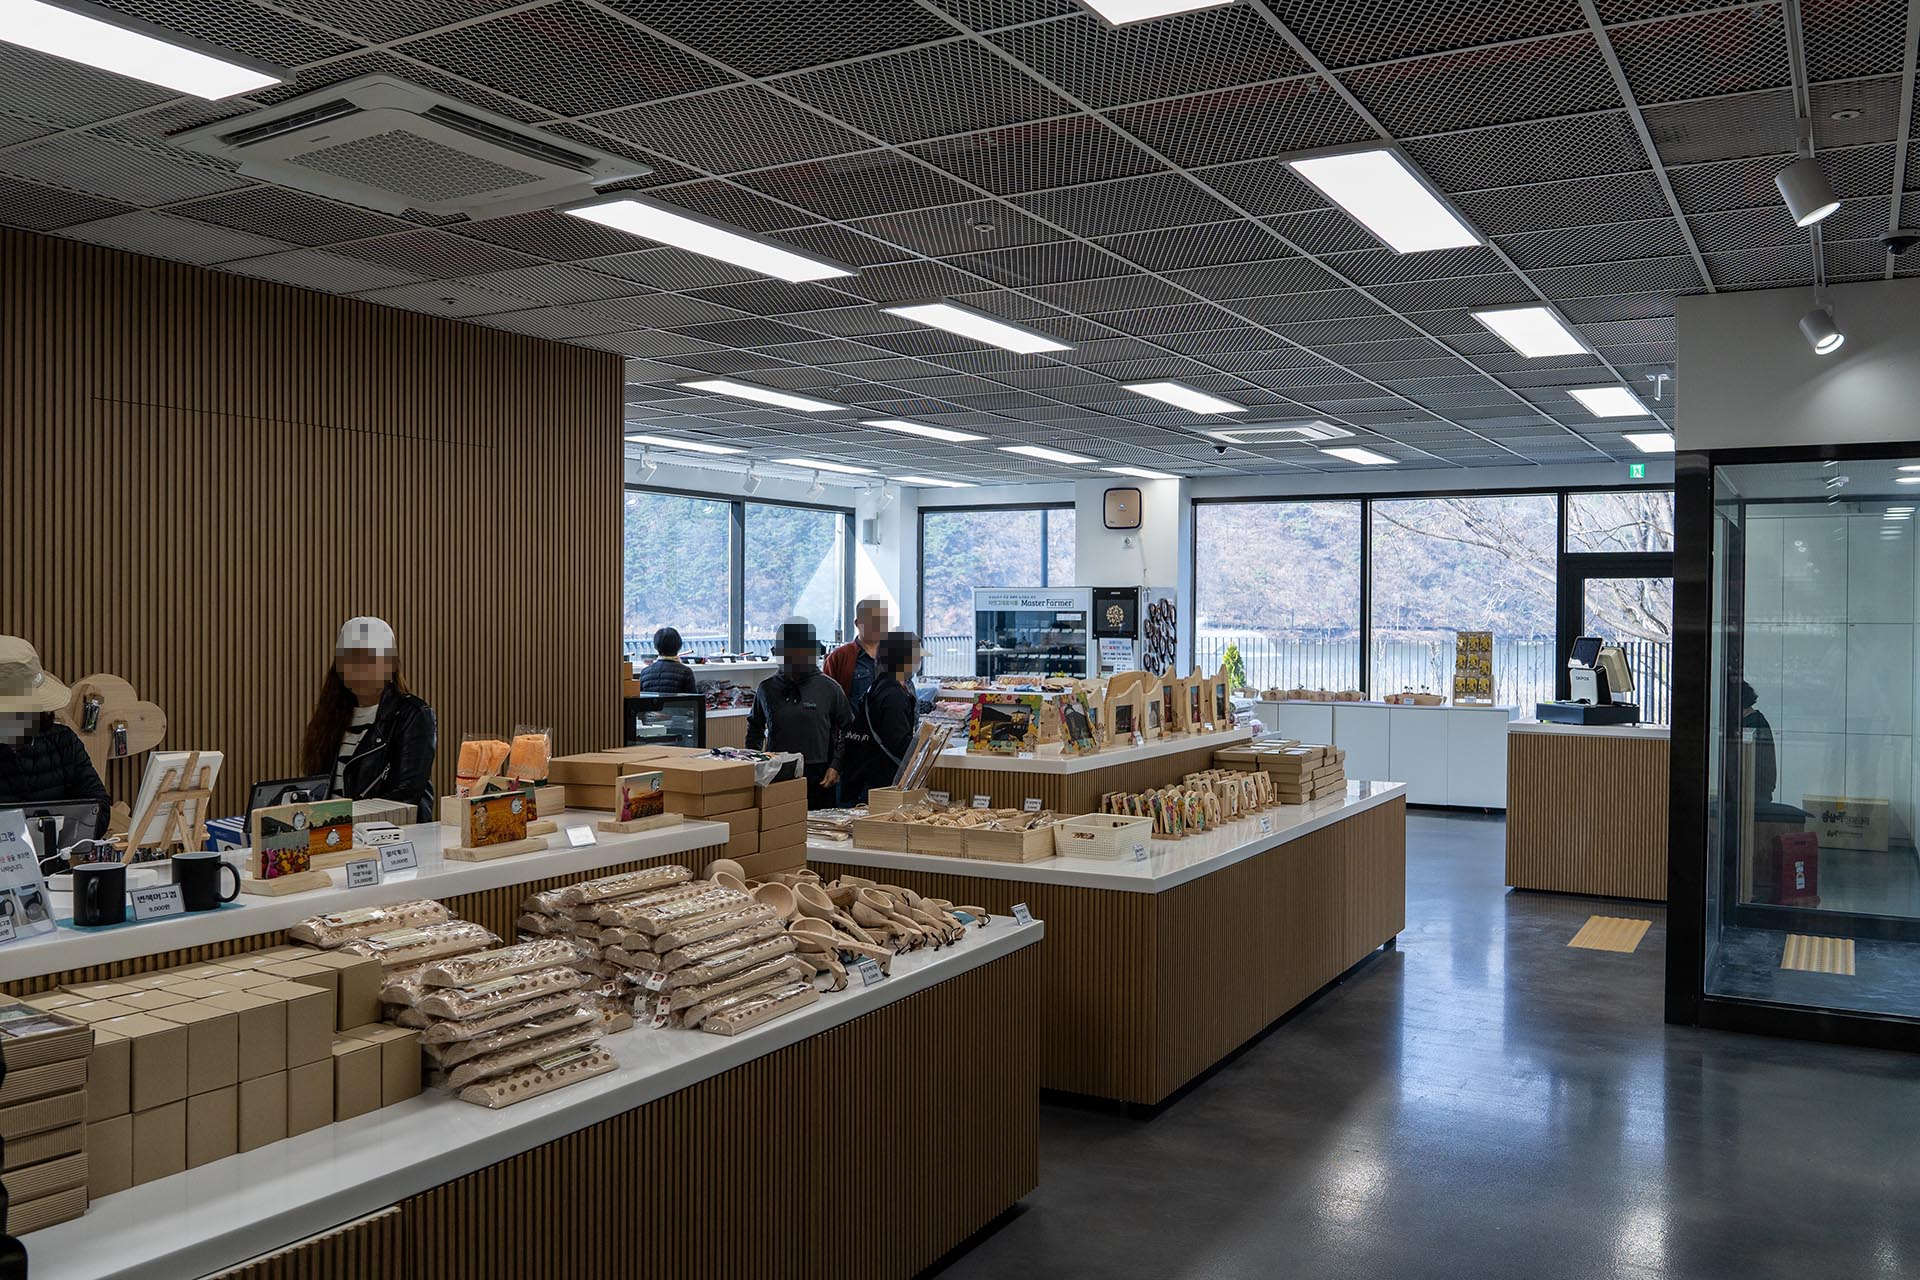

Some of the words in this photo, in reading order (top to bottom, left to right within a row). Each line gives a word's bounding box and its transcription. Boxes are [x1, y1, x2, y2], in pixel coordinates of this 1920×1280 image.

[1021, 599, 1045, 607] Master
[1046, 599, 1073, 607] Farmer
[0, 831, 16, 842] 그컵
[137, 891, 177, 903] 변색머그컵
[148, 904, 170, 912] 9,000원
